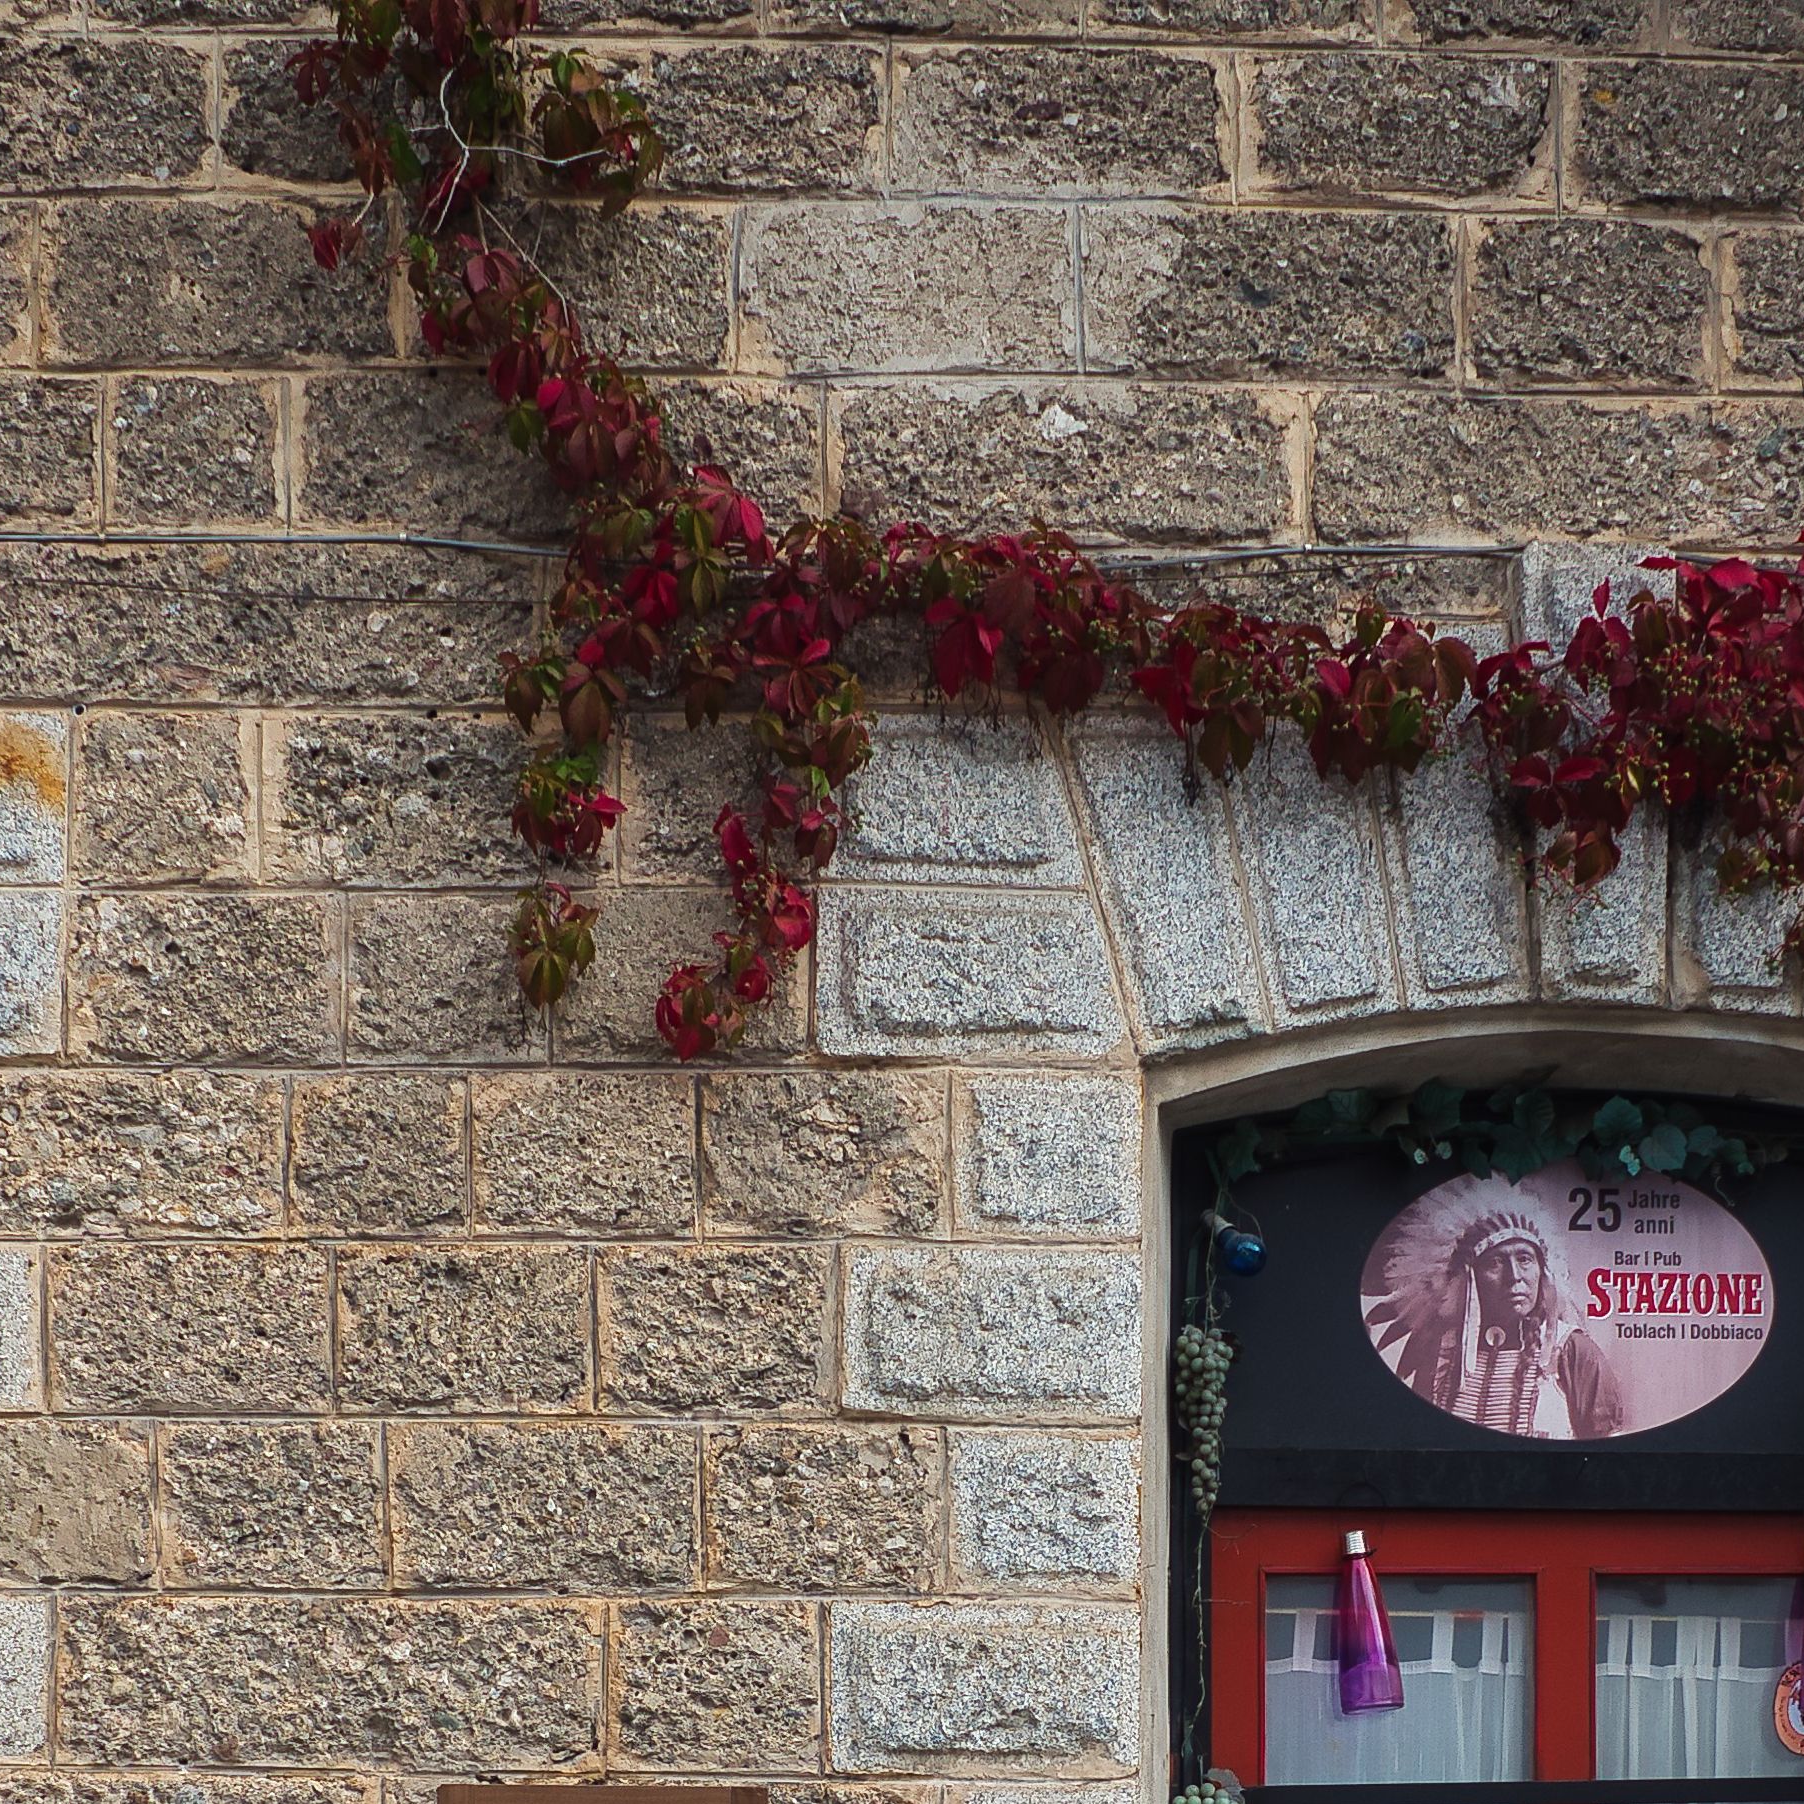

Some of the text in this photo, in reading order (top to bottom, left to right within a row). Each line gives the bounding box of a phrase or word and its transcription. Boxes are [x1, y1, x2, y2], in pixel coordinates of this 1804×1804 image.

[1567, 1187, 1681, 1233] 25 Jahre
[1634, 1216, 1675, 1236] anni
[1614, 1250, 1682, 1267] Bar Pub
[1586, 1267, 1764, 1319] STAZIONE
[1615, 1322, 1764, 1341] Toblach Dobbiaco
